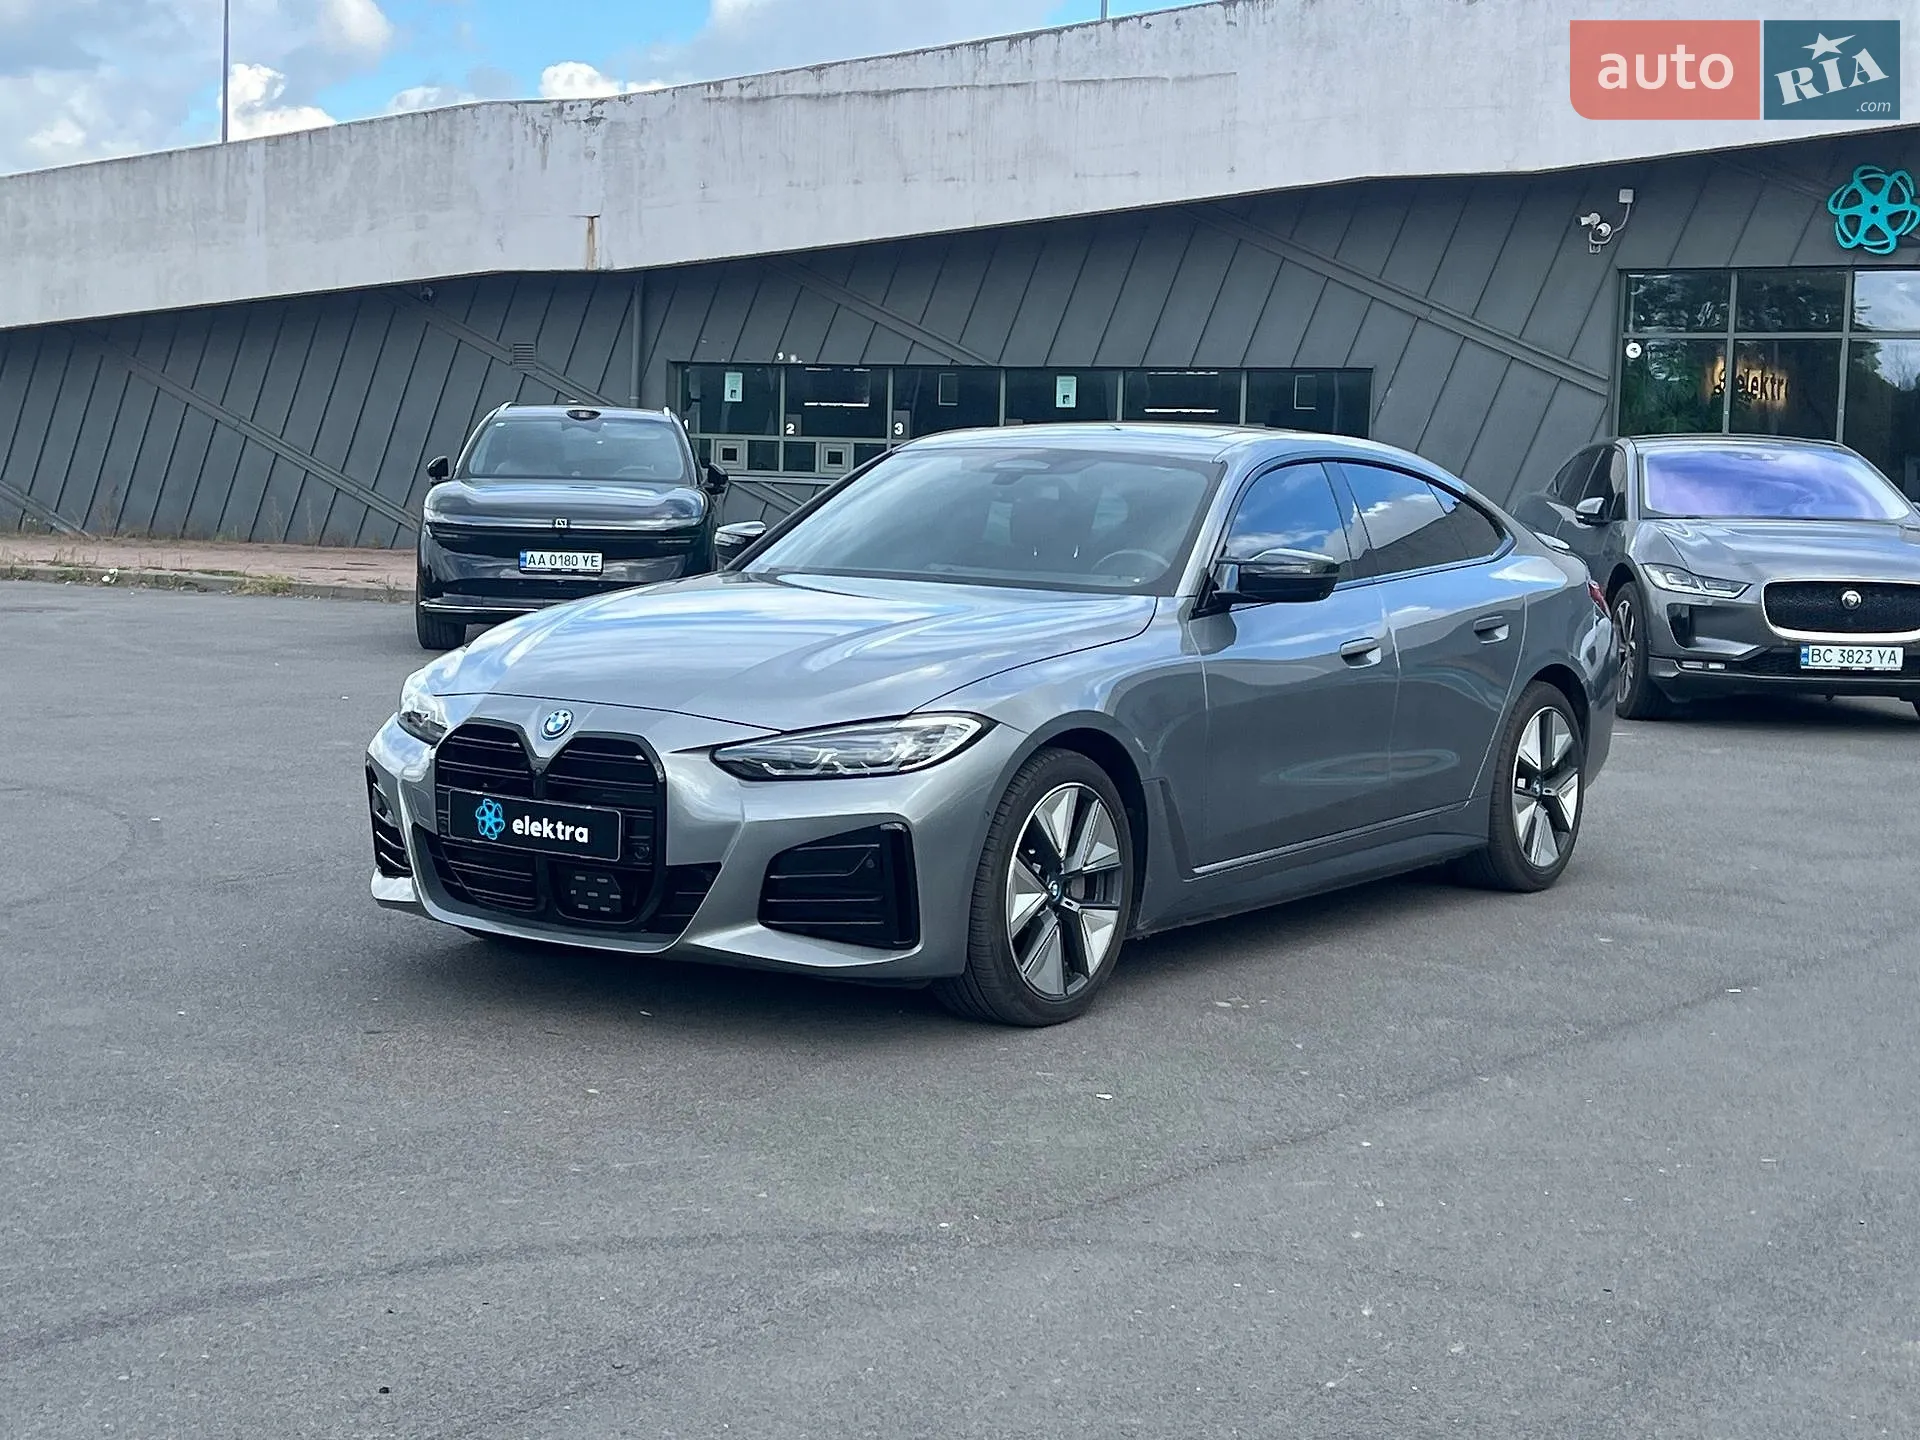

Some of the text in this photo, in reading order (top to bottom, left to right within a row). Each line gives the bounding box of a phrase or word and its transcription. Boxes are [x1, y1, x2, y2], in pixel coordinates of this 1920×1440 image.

[1736, 369, 1789, 400] elektr
[786, 424, 795, 435] 2
[894, 423, 904, 435] 3
[528, 554, 599, 567] AA 0180 YE
[1811, 648, 1897, 664] BC 3823 YA
[512, 815, 589, 844] elektra
